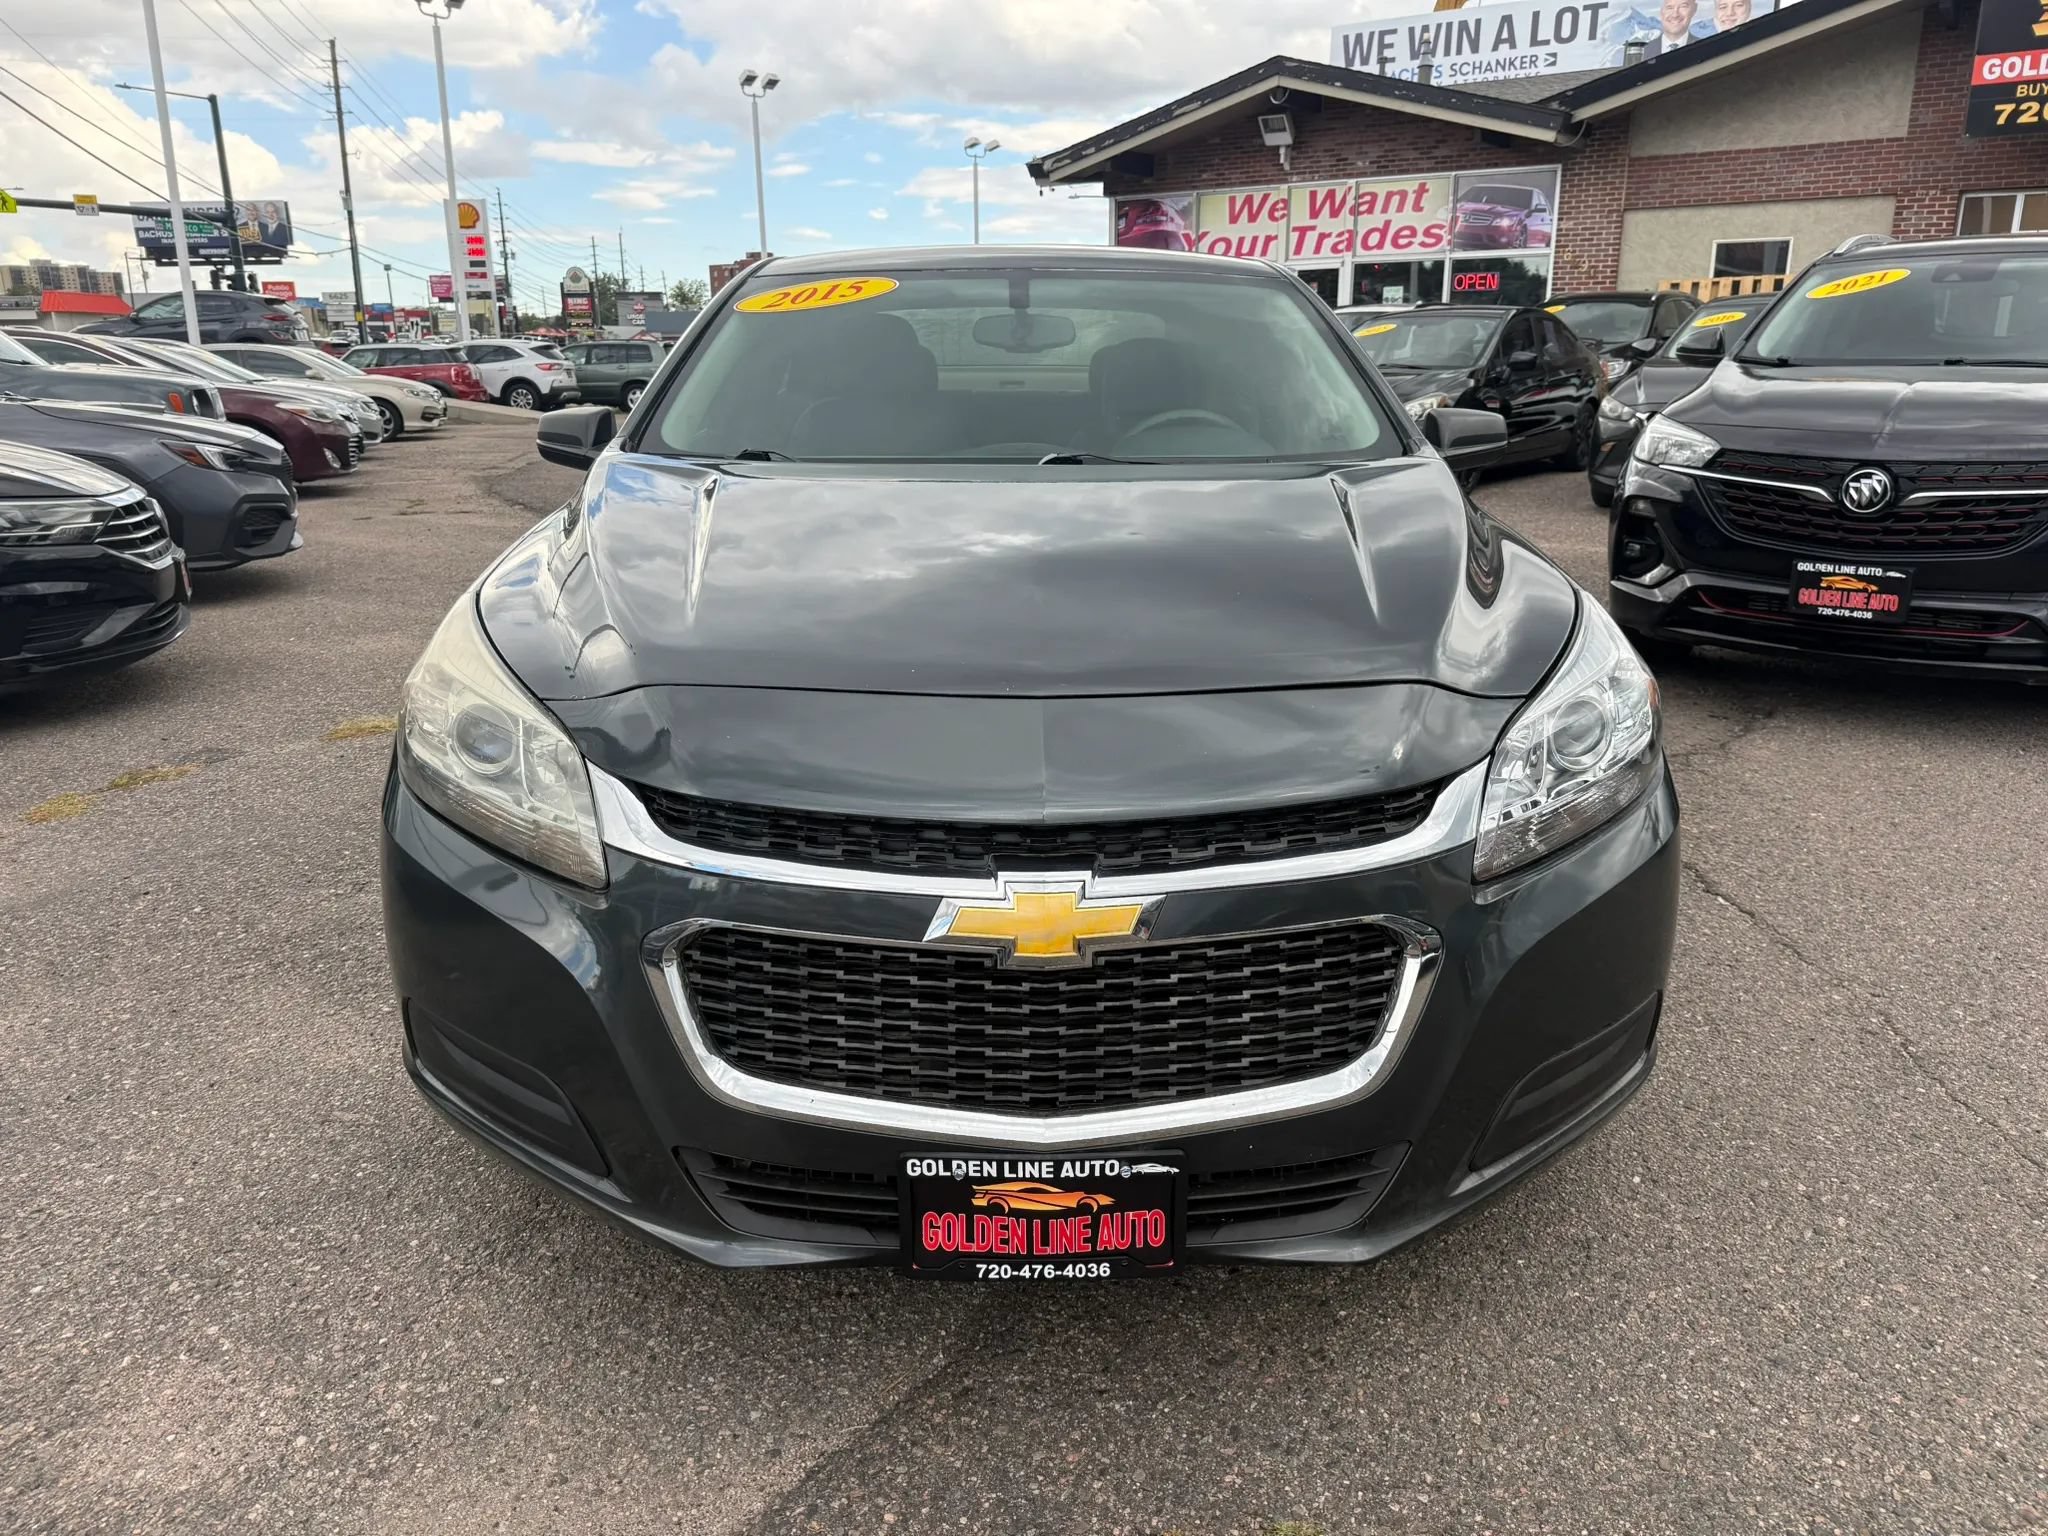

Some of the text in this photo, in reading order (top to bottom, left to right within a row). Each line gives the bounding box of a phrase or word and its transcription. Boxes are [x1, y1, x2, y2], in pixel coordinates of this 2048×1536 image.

[1343, 2, 1609, 68] WE WIN A LOT
[1449, 54, 1539, 78] SCHANKER
[1994, 101, 2048, 125] 72
[1228, 182, 1430, 225] We Want
[1181, 231, 1279, 258] Your
[1454, 273, 1499, 291] OPEN
[1825, 271, 1889, 296] 2021
[761, 280, 869, 310] 2015
[1797, 562, 1882, 576] GOLDEN LINE AUTO
[1798, 588, 1899, 611] GOLDEN LINE AUTO
[1818, 607, 1873, 619] 720-476-4036
[906, 1159, 1120, 1178] GOLDEN LINE AUTO
[922, 1209, 1166, 1255] GOLDEN LINE AUTO
[976, 1262, 1111, 1280] 720-476-4036
